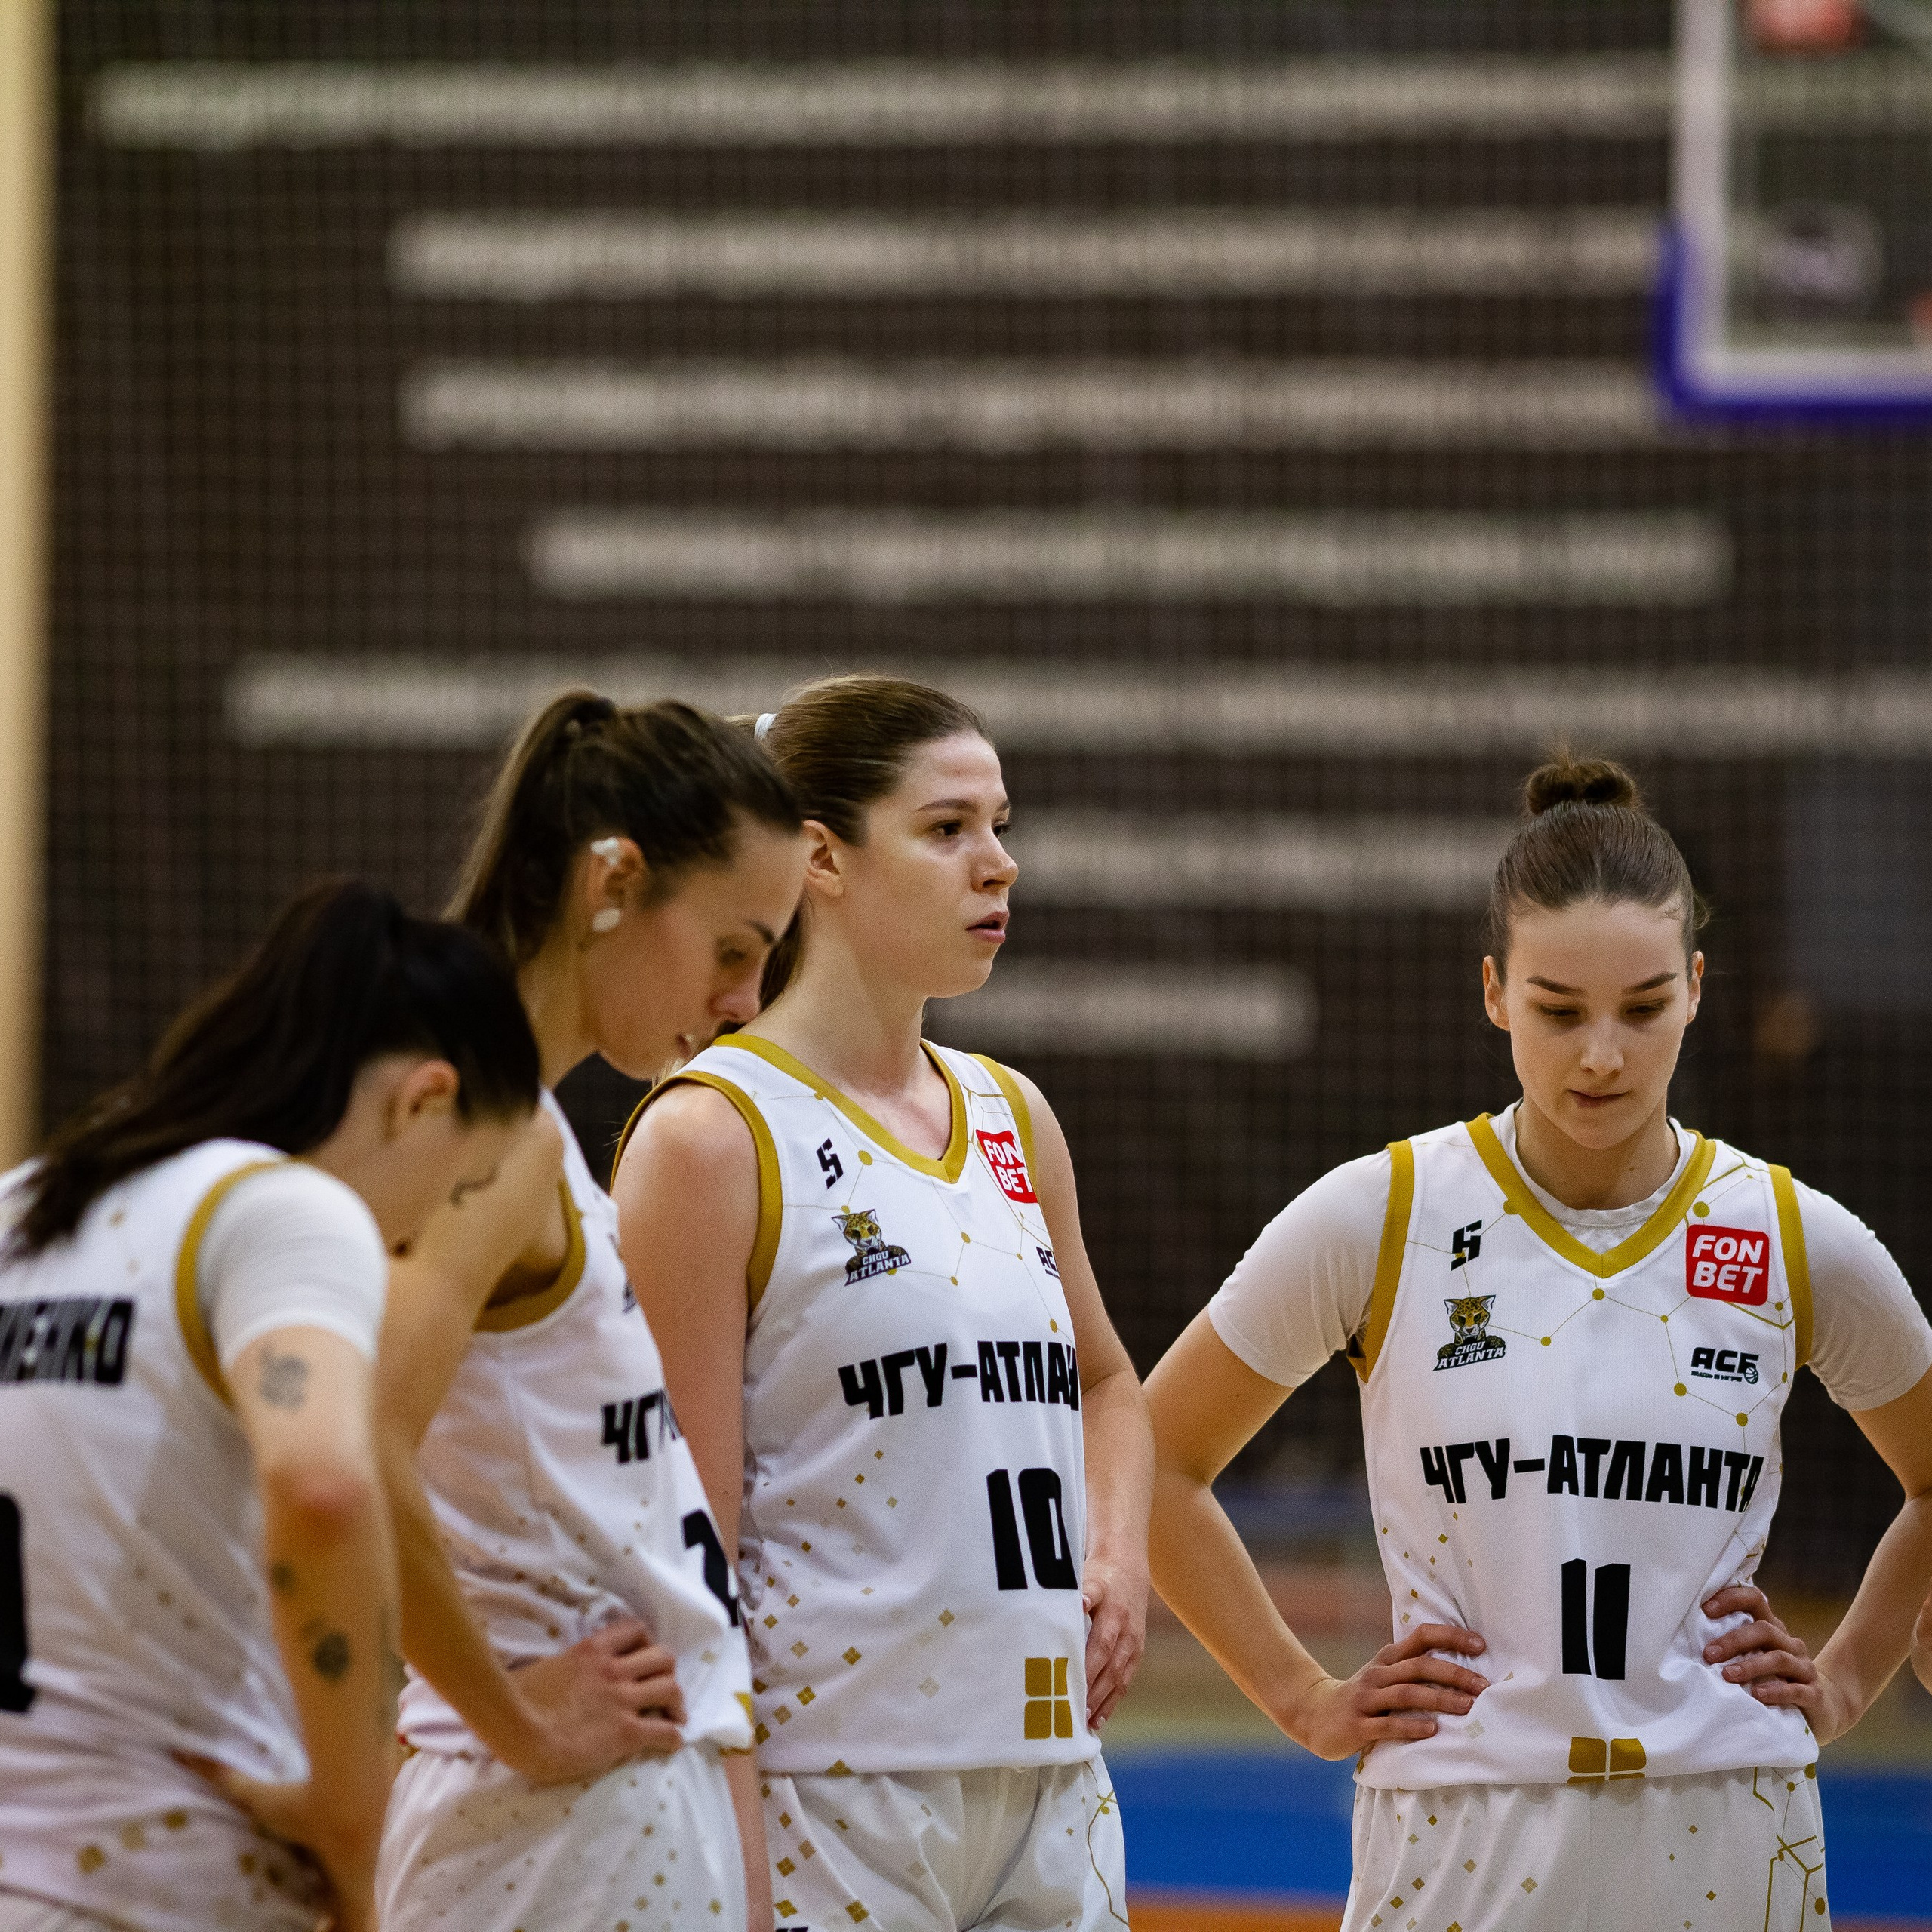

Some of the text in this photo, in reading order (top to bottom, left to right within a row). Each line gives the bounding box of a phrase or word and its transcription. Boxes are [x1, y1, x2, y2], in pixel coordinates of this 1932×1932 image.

[983, 1139, 1024, 1165] FON
[995, 1165, 1034, 1192] BET
[1692, 1234, 1764, 1264] FON
[849, 1253, 909, 1282] ATLANTA
[1692, 1260, 1764, 1294] BET
[1437, 1346, 1504, 1369] ATLANTA
[1454, 1340, 1486, 1356] CHGU
[1420, 1435, 1764, 1513] ЧГУ-АТЛАНТА
[986, 1467, 1078, 1591] 10
[1561, 1558, 1631, 1681] 11
